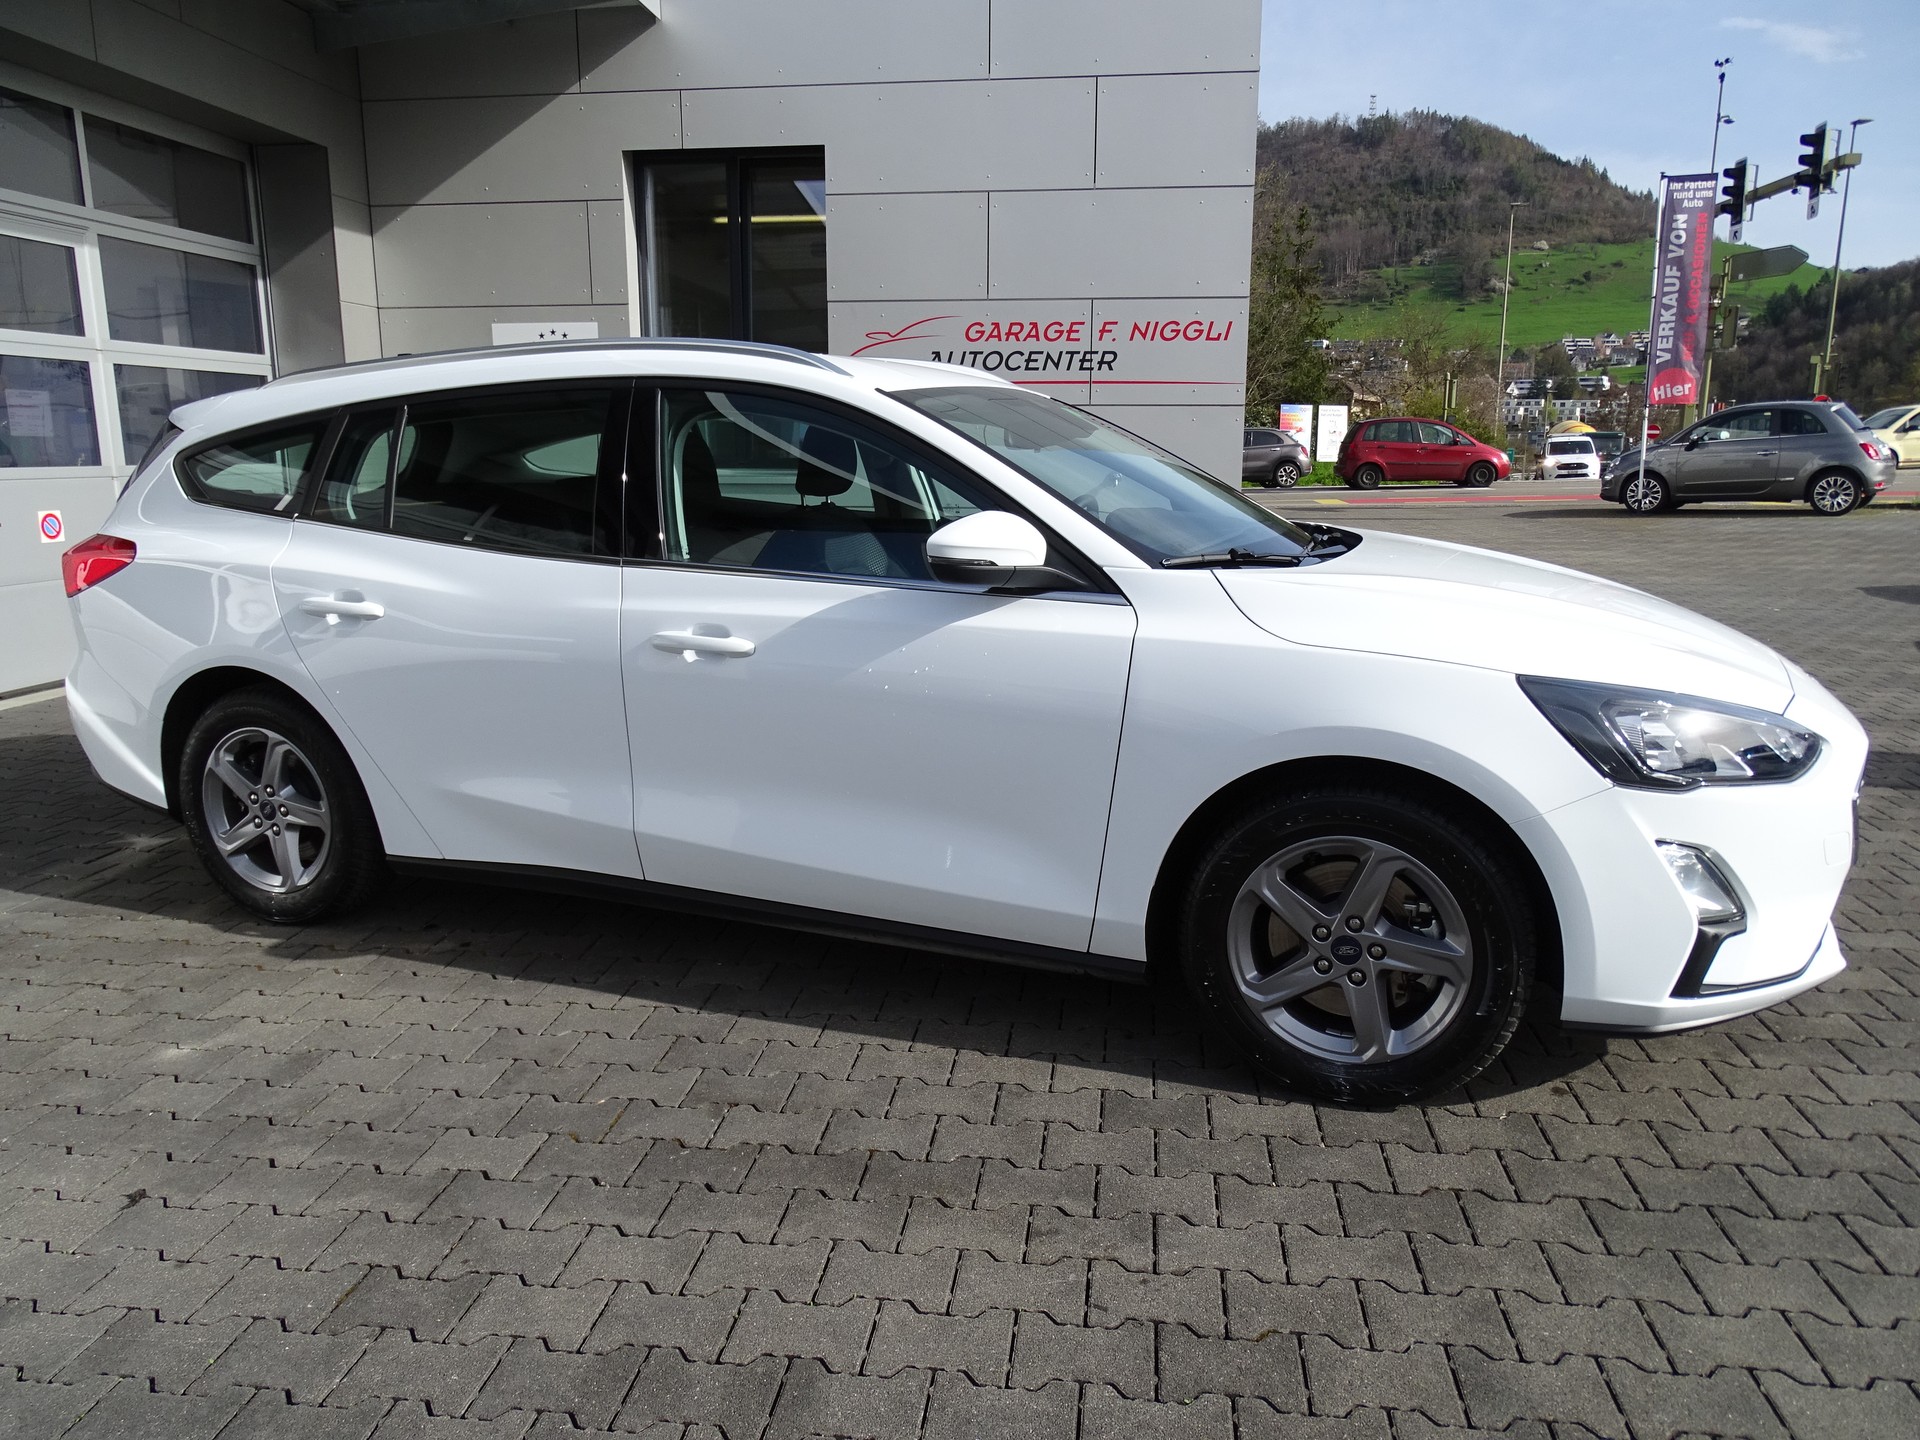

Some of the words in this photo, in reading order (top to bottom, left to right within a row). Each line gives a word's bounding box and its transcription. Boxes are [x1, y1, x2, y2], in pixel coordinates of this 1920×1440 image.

[1673, 190, 1693, 199] rund
[1695, 190, 1713, 198] ums
[1684, 180, 1716, 189] Partner
[1682, 199, 1704, 208] Auto
[1667, 213, 1689, 258] VON
[1685, 212, 1708, 310] OCCASIONEN
[1655, 265, 1681, 365] VERKAUF
[964, 321, 1085, 343] GARAGE
[1097, 321, 1118, 342] F.
[1129, 320, 1233, 342] NIGGLI
[930, 350, 1118, 372] AUTOCENTER
[1653, 381, 1692, 401] Hier
